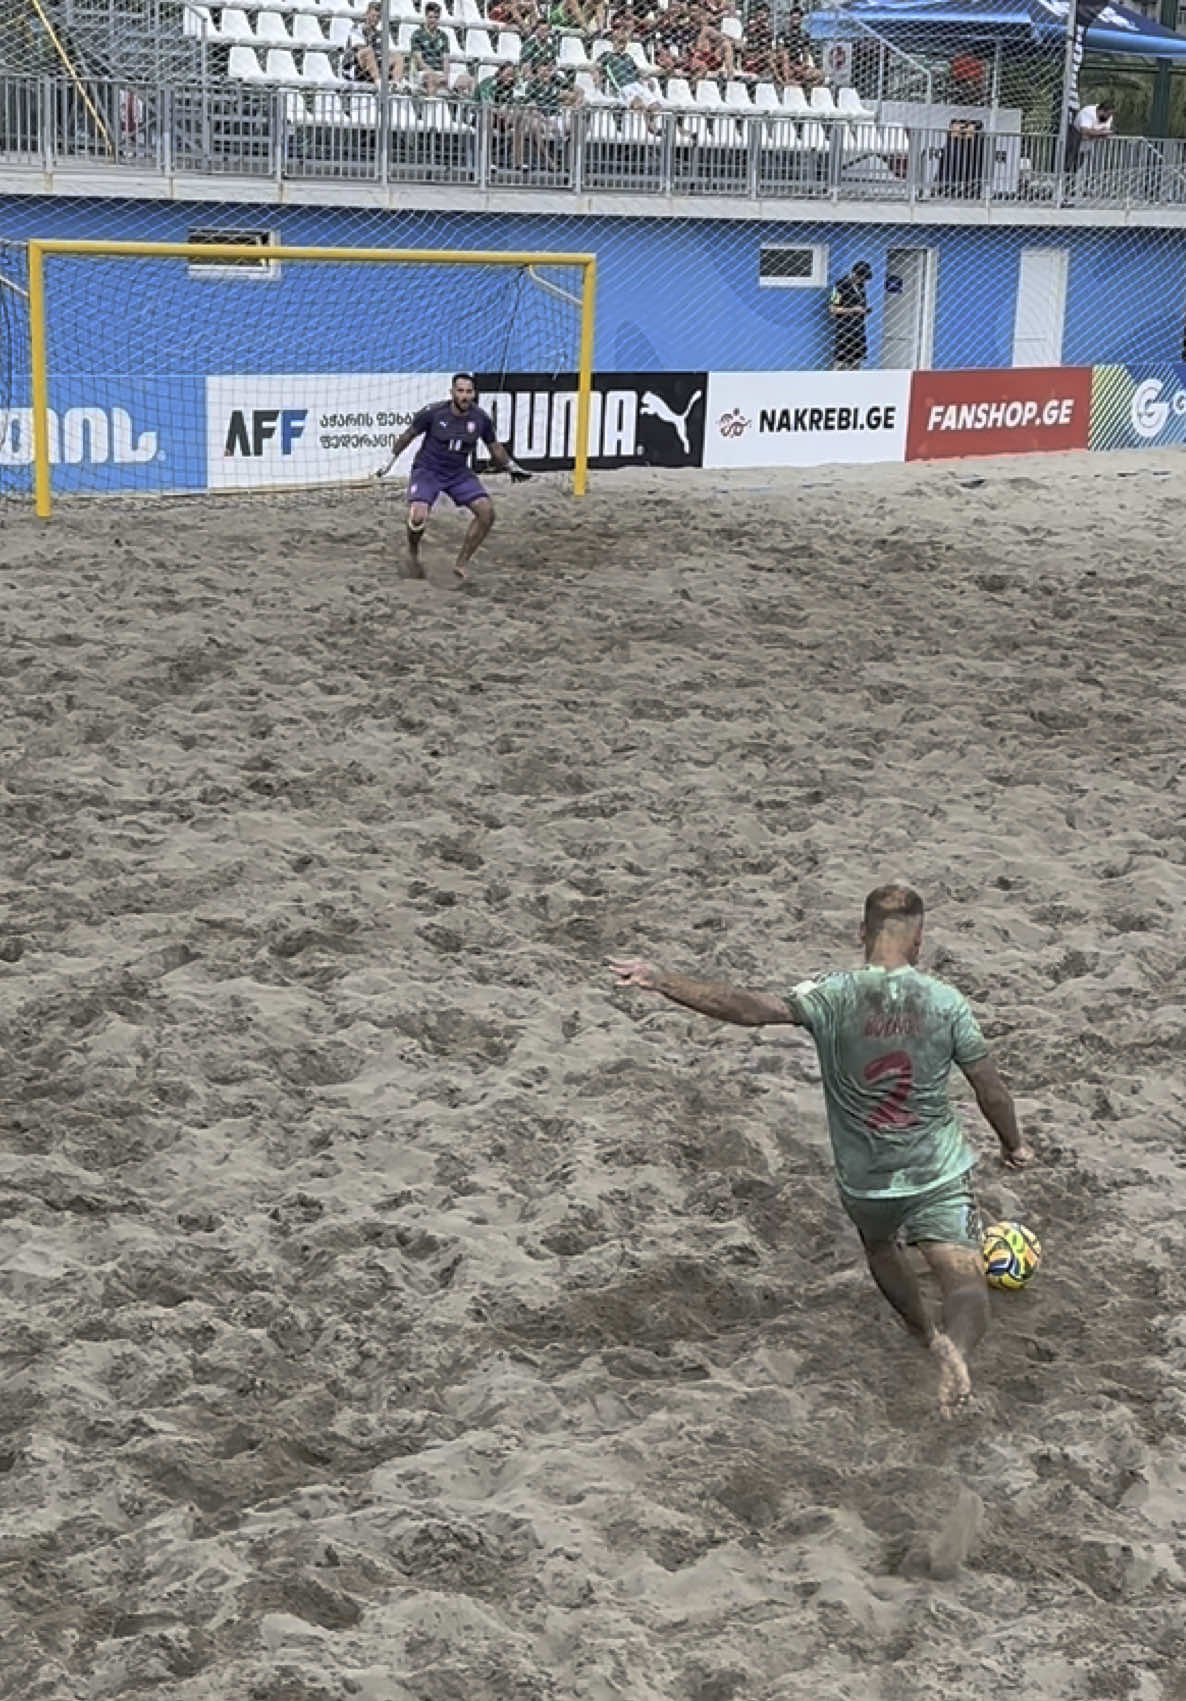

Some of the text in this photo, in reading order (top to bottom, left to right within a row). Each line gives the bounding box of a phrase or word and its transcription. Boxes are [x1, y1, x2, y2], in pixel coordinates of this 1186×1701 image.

[223, 409, 309, 457] AFF
[759, 406, 896, 433] NAKREBI.GE
[927, 399, 1075, 431] FANSHOP.GE
[863, 1051, 920, 1130] 2
